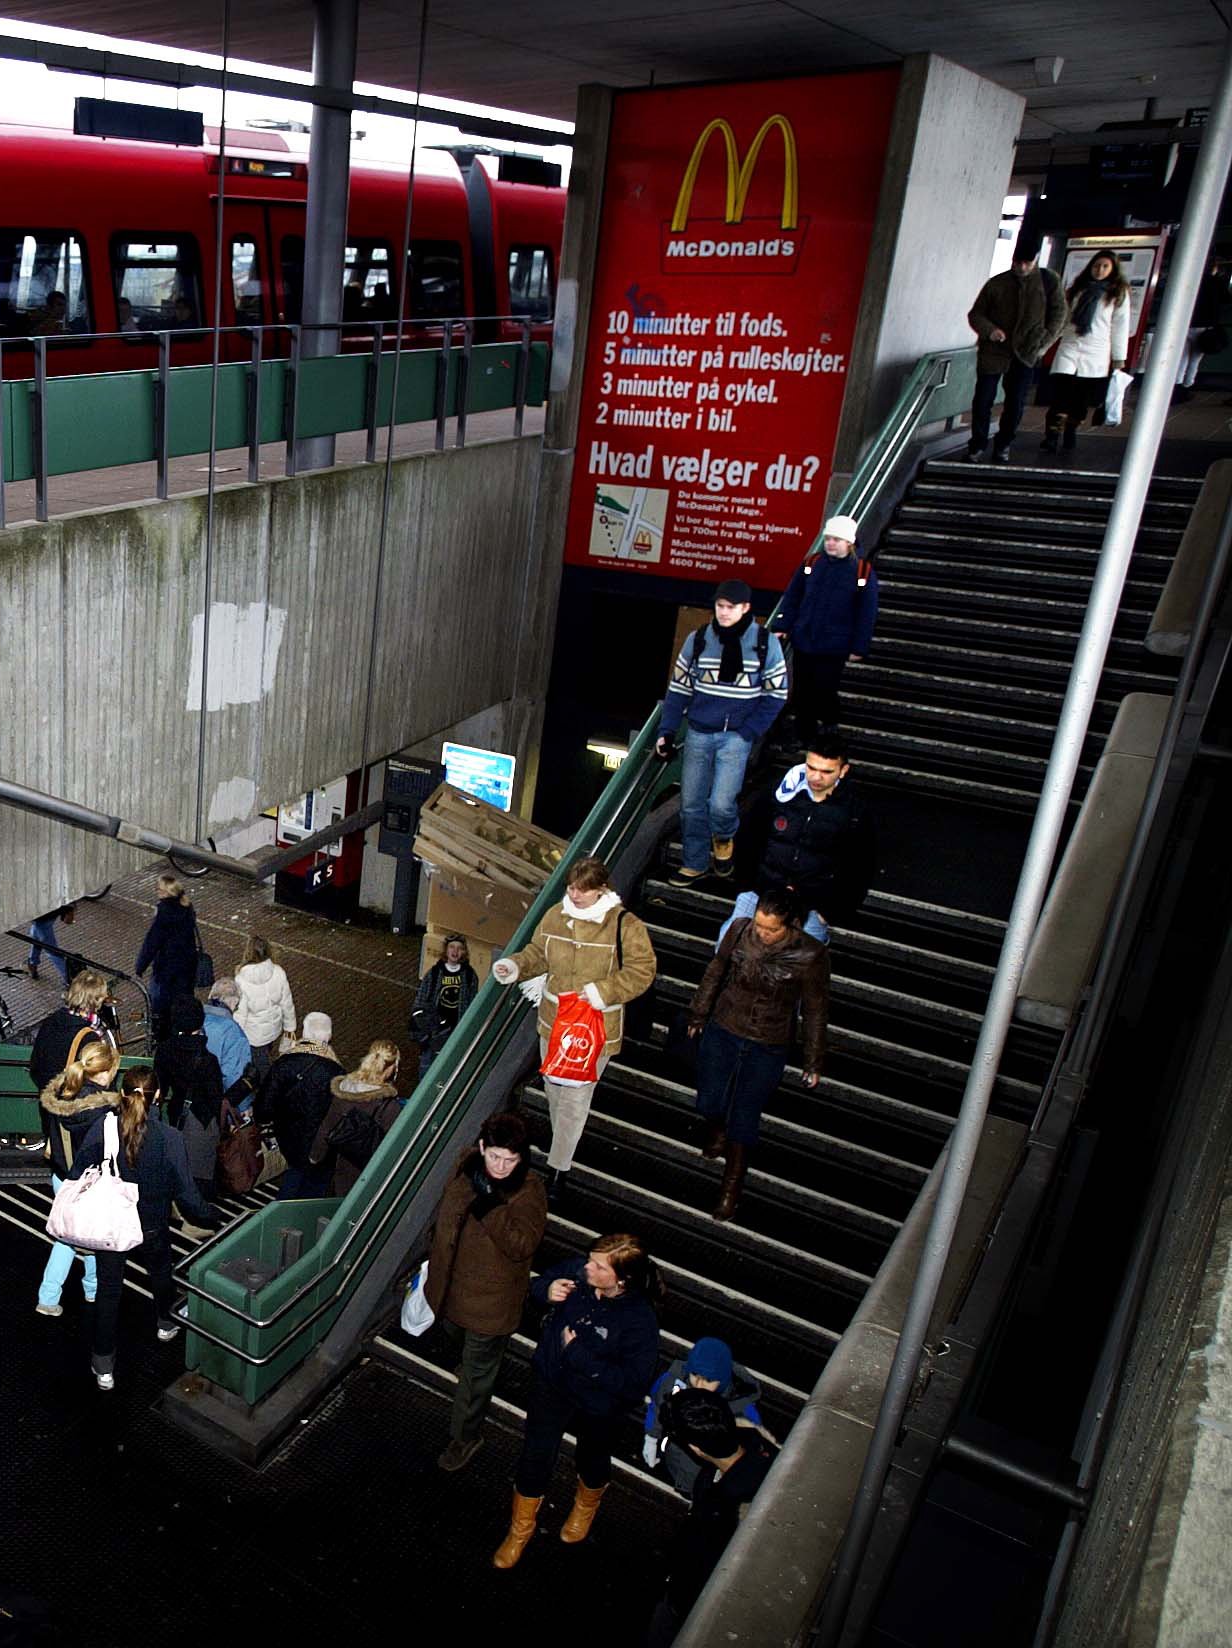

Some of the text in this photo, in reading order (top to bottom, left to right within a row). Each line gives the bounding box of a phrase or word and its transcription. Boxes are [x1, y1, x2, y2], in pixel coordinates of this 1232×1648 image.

[666, 239, 795, 257] McDonald's
[607, 310, 788, 337] 10 minutter til fods.
[603, 341, 846, 376] 5 minutter på rulleskøjter.
[600, 371, 778, 406] 3 minutter på cykel.
[595, 402, 737, 432] 2 minutter i bil.
[588, 440, 821, 493] Hvad vælger du?
[678, 490, 691, 499] Du
[757, 497, 767, 506] til
[692, 526, 718, 536] 700m
